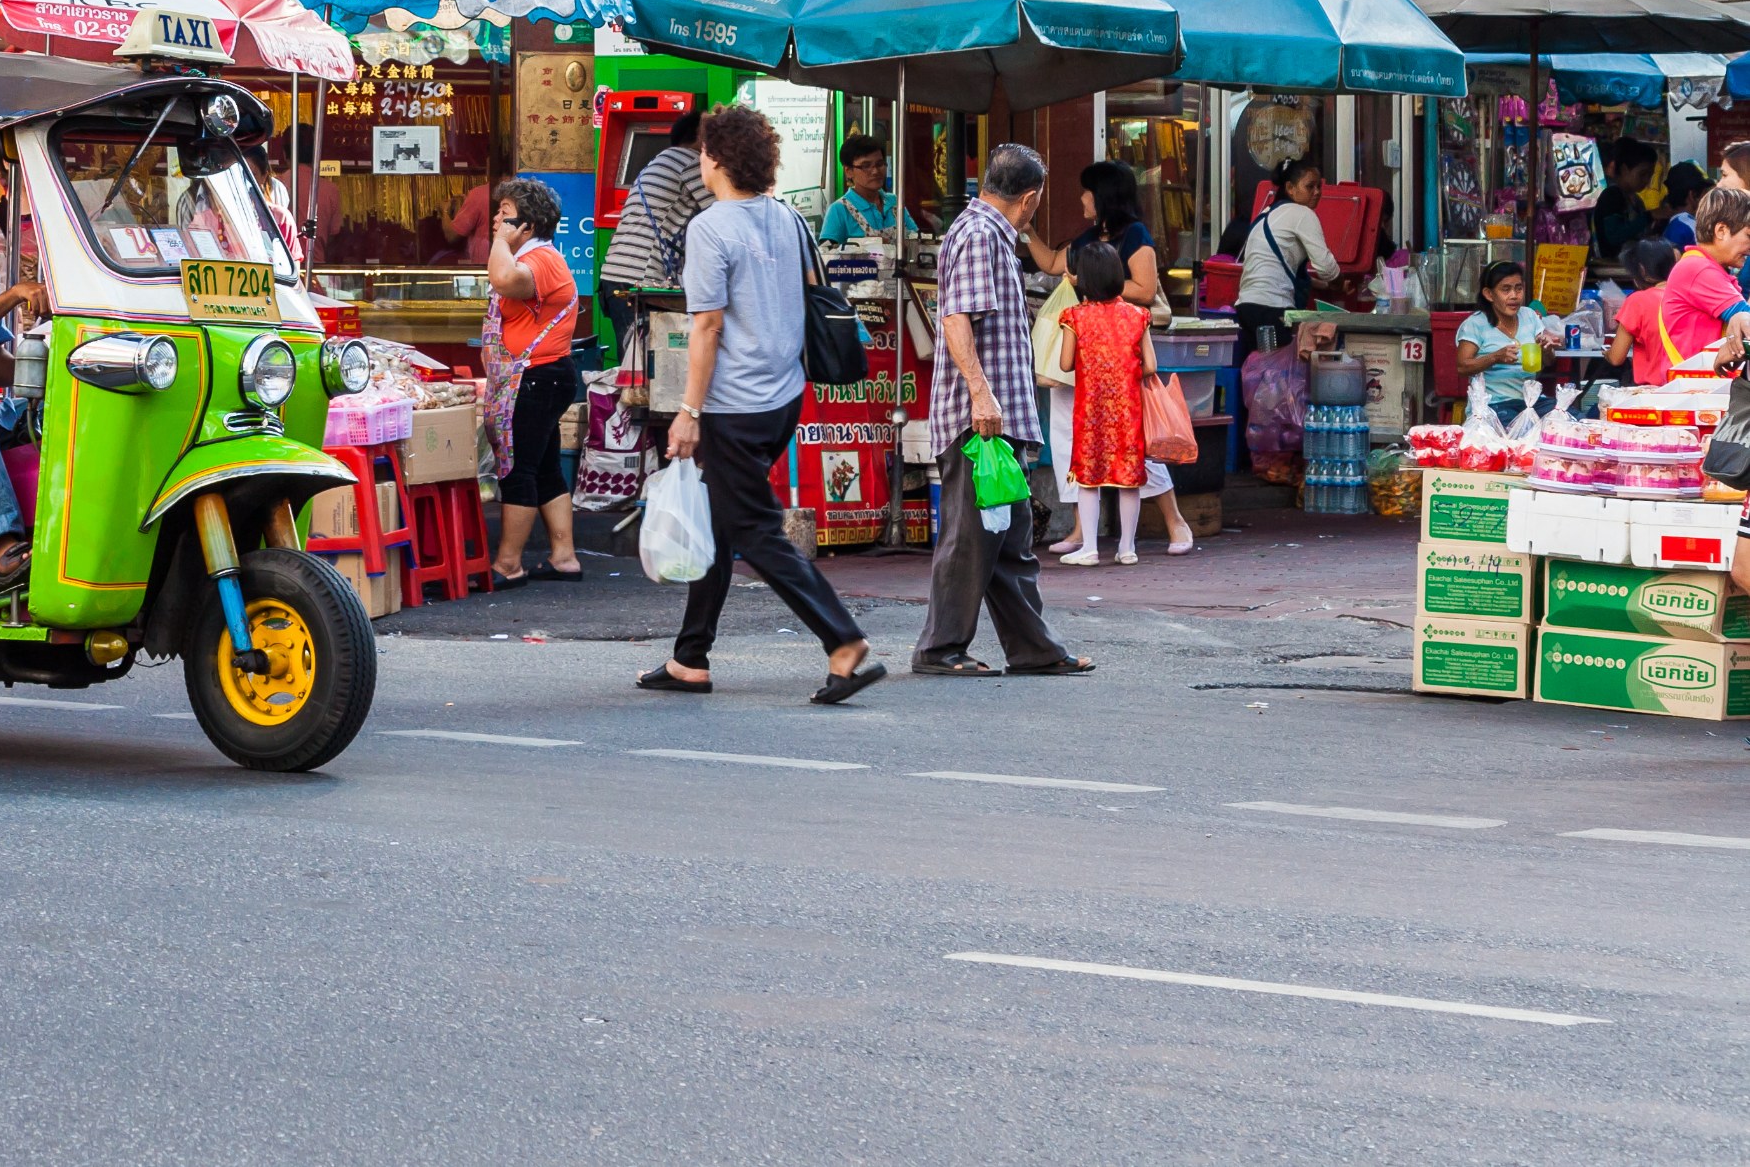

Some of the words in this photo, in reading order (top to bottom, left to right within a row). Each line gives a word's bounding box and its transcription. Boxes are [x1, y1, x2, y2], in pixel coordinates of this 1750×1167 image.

[35, 2, 129, 22] สาขาเยาวราช
[158, 14, 213, 49] TAXI
[694, 19, 738, 46] 1595
[1146, 29, 1168, 45] (ไทย)
[1436, 73, 1455, 87] (ไทย)
[224, 266, 272, 297] 7204
[1404, 342, 1423, 360] 13
[1558, 580, 1628, 597] ekachai
[1649, 592, 1709, 611] เอกชัย
[1553, 652, 1626, 670] ekachai
[1648, 664, 1709, 683] เอกชัย
